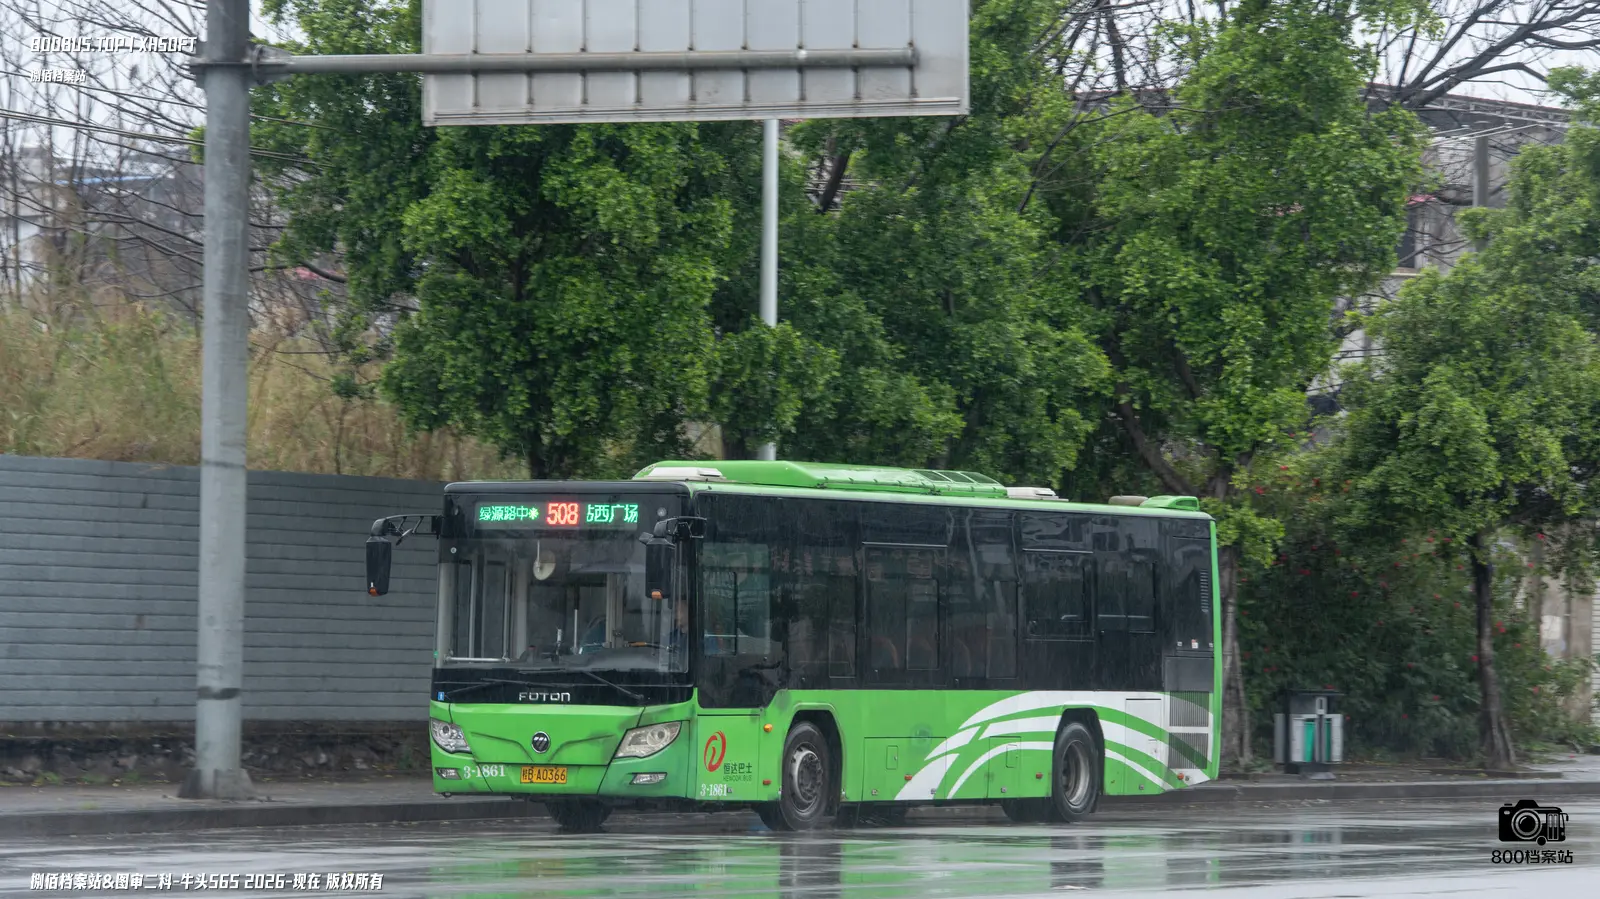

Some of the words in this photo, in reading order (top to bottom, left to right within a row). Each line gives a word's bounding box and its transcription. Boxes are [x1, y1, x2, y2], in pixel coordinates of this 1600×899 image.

[546, 502, 580, 525] 508
[518, 691, 571, 702] FOTON
[463, 765, 506, 779] 3-1861
[723, 762, 753, 775] 恒达巴士
